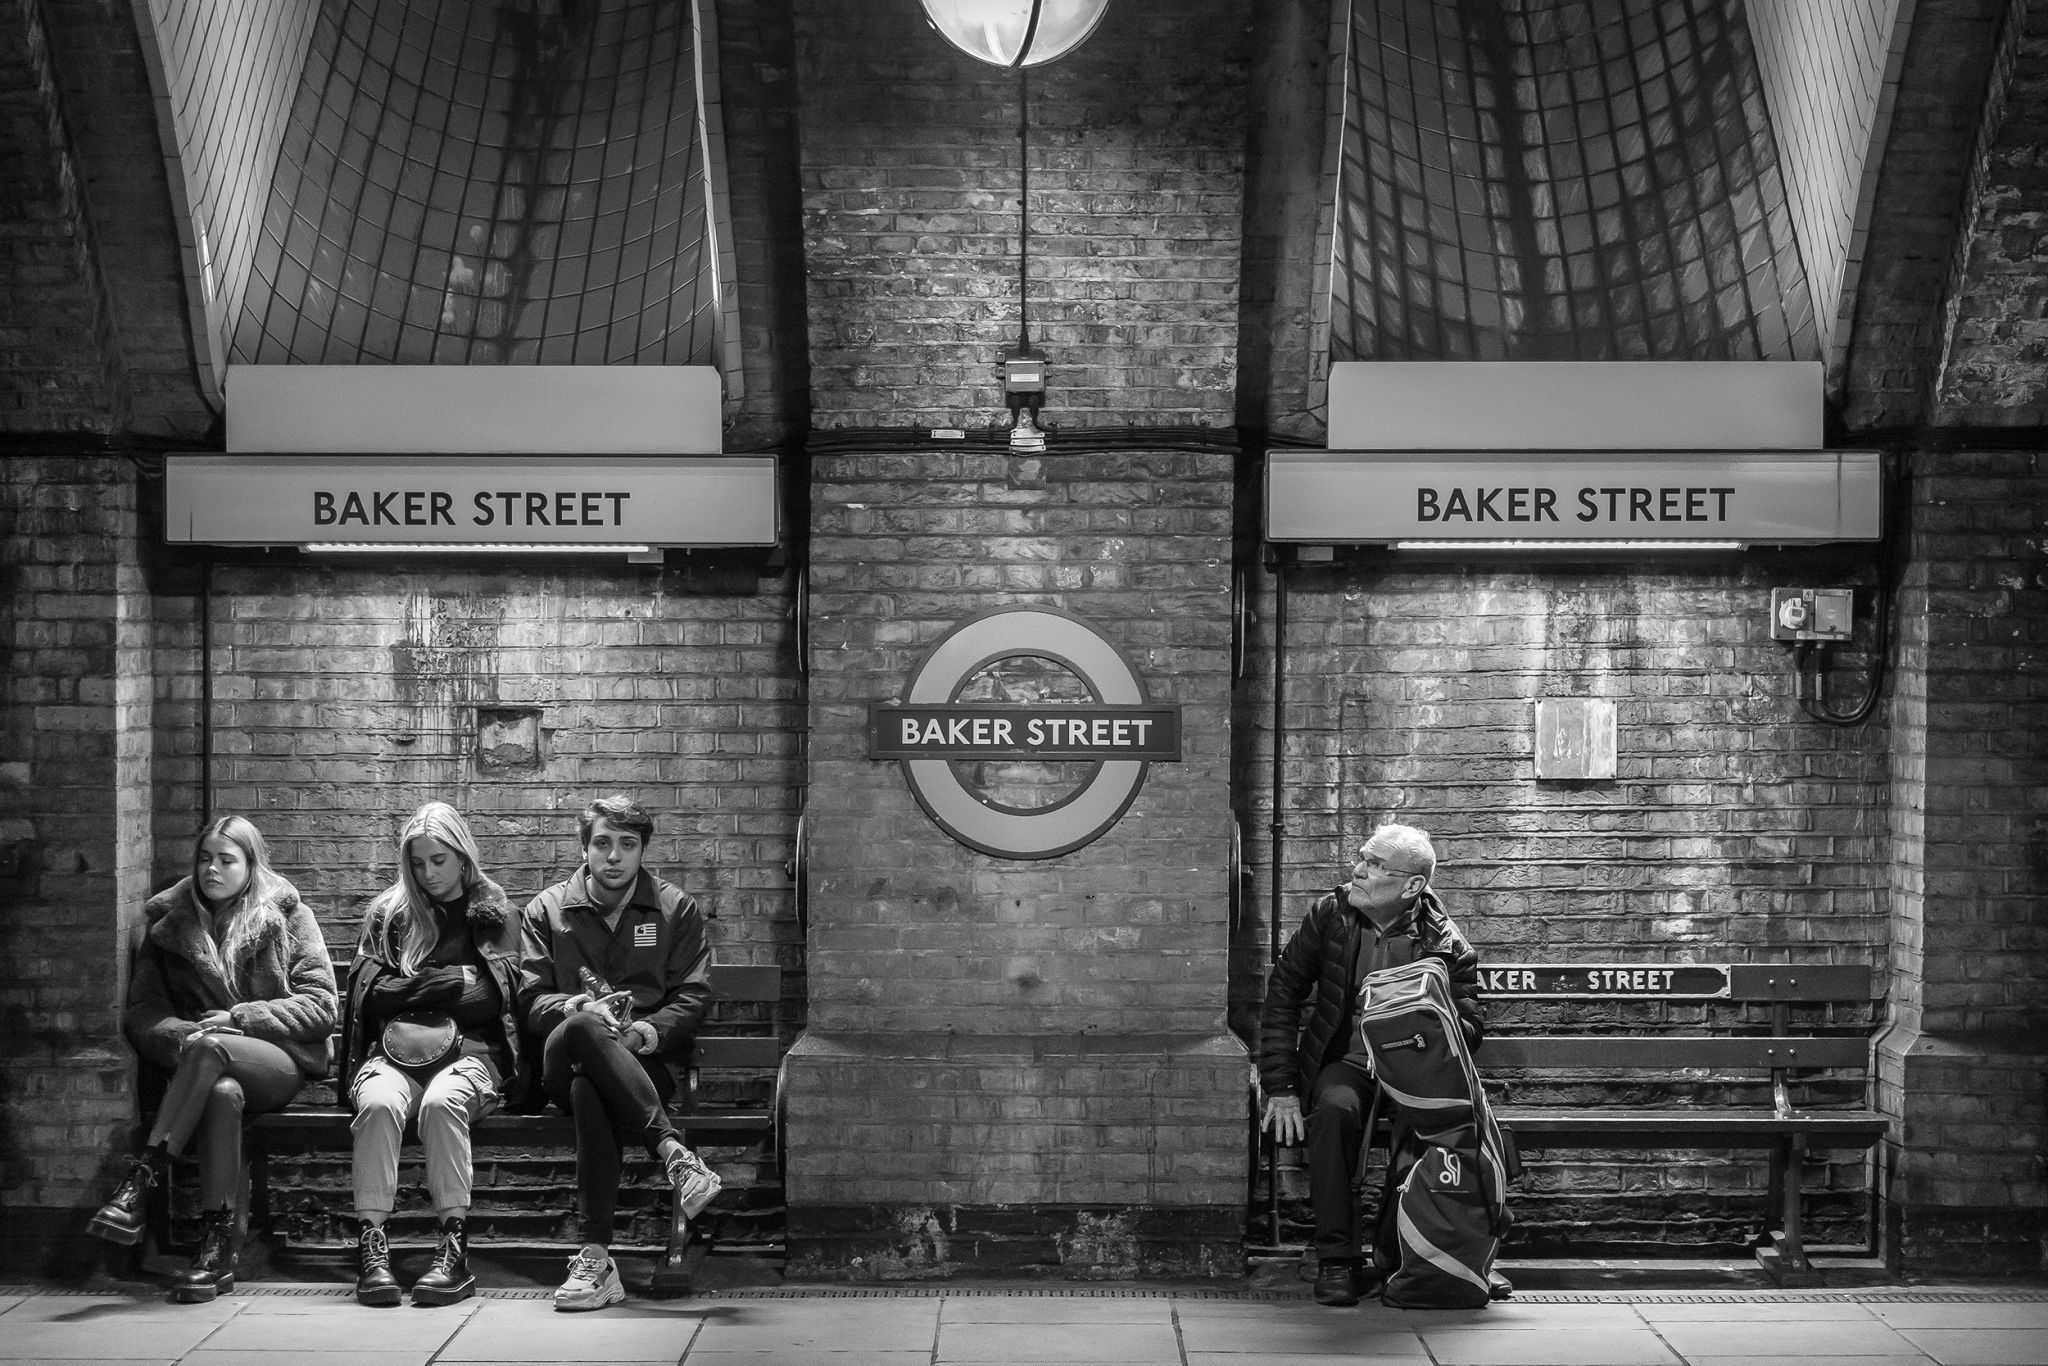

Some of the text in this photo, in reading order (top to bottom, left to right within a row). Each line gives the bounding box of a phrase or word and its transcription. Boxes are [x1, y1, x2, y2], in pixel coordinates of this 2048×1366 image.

[314, 491, 631, 527] BAKER STREET
[1417, 487, 1736, 523] BAKER STREET
[901, 718, 1153, 746] BAKER STREET
[1476, 970, 1674, 991] AKER STREET
